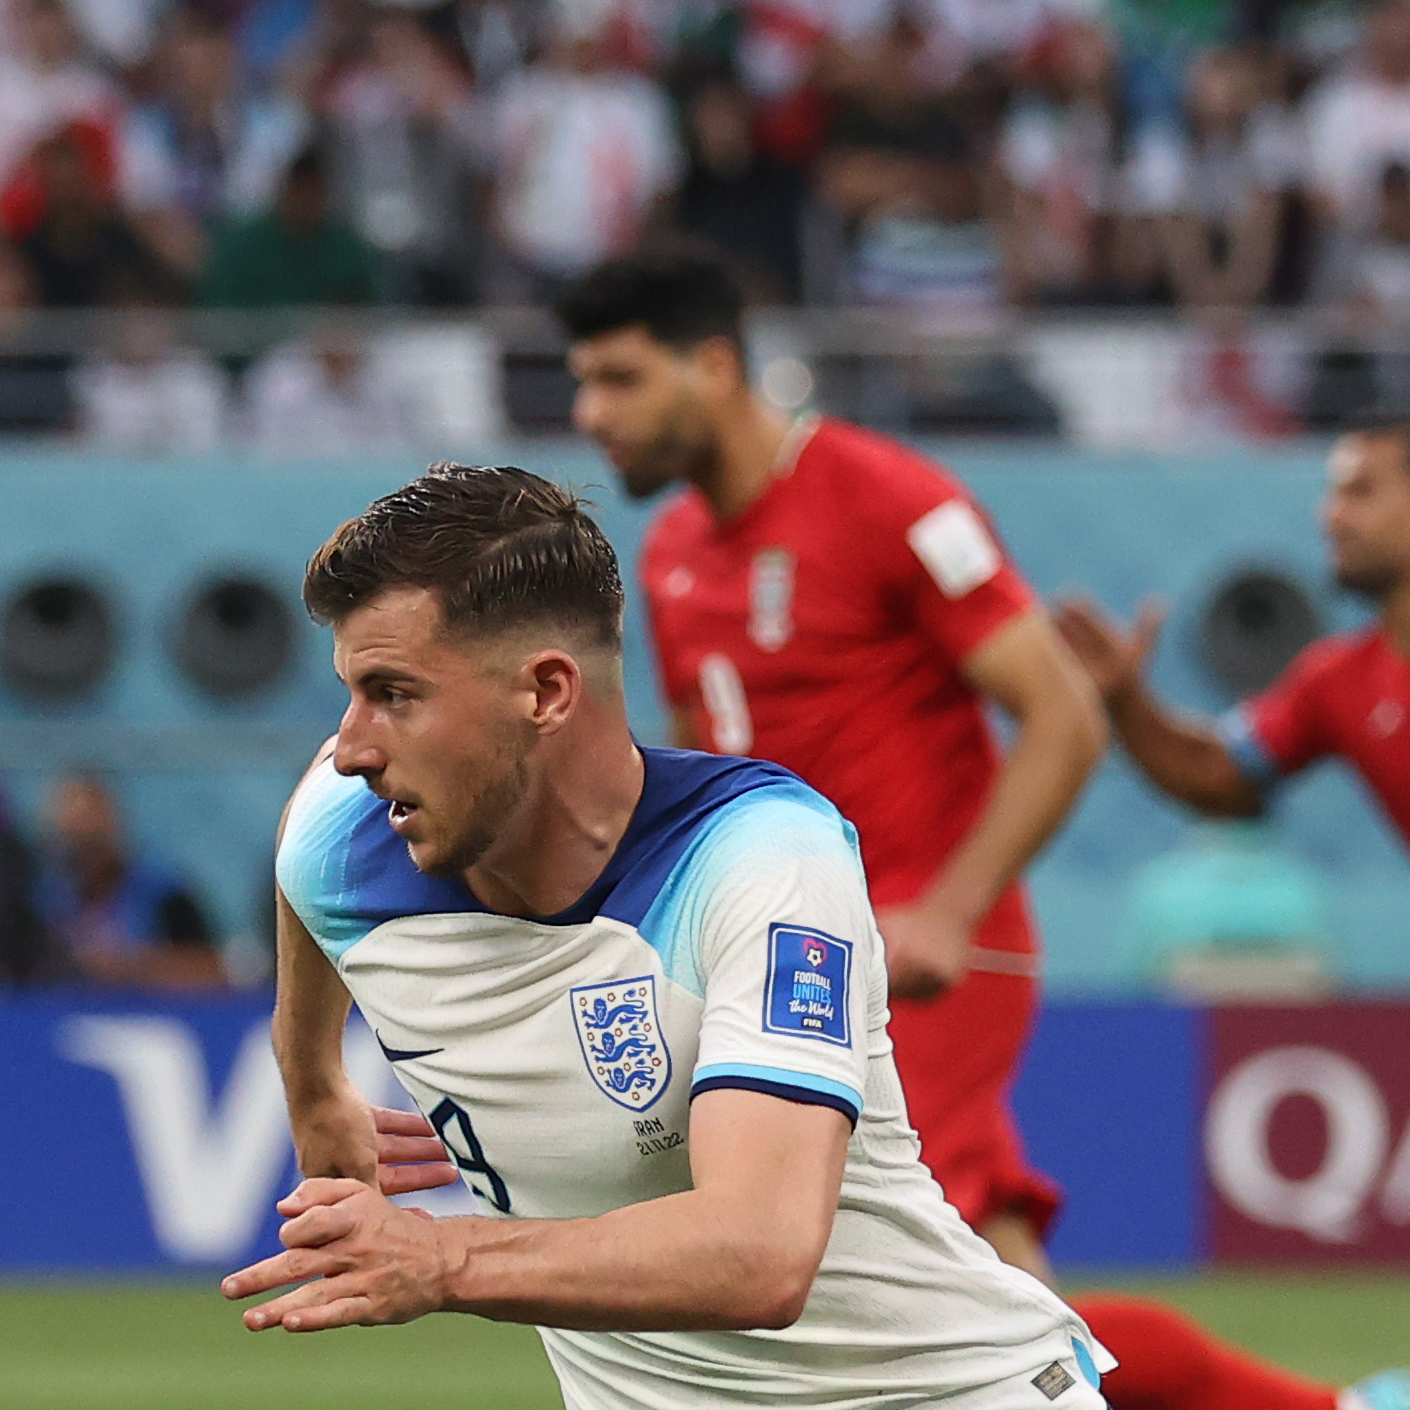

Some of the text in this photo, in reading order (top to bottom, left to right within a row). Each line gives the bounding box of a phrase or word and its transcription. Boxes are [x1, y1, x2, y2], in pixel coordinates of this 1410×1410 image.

[793, 970, 832, 991] FOOTBALL
[792, 983, 833, 1006] UNITES
[788, 999, 835, 1022] the World
[802, 1018, 823, 1029] FIFA
[632, 1116, 665, 1137] IRAN
